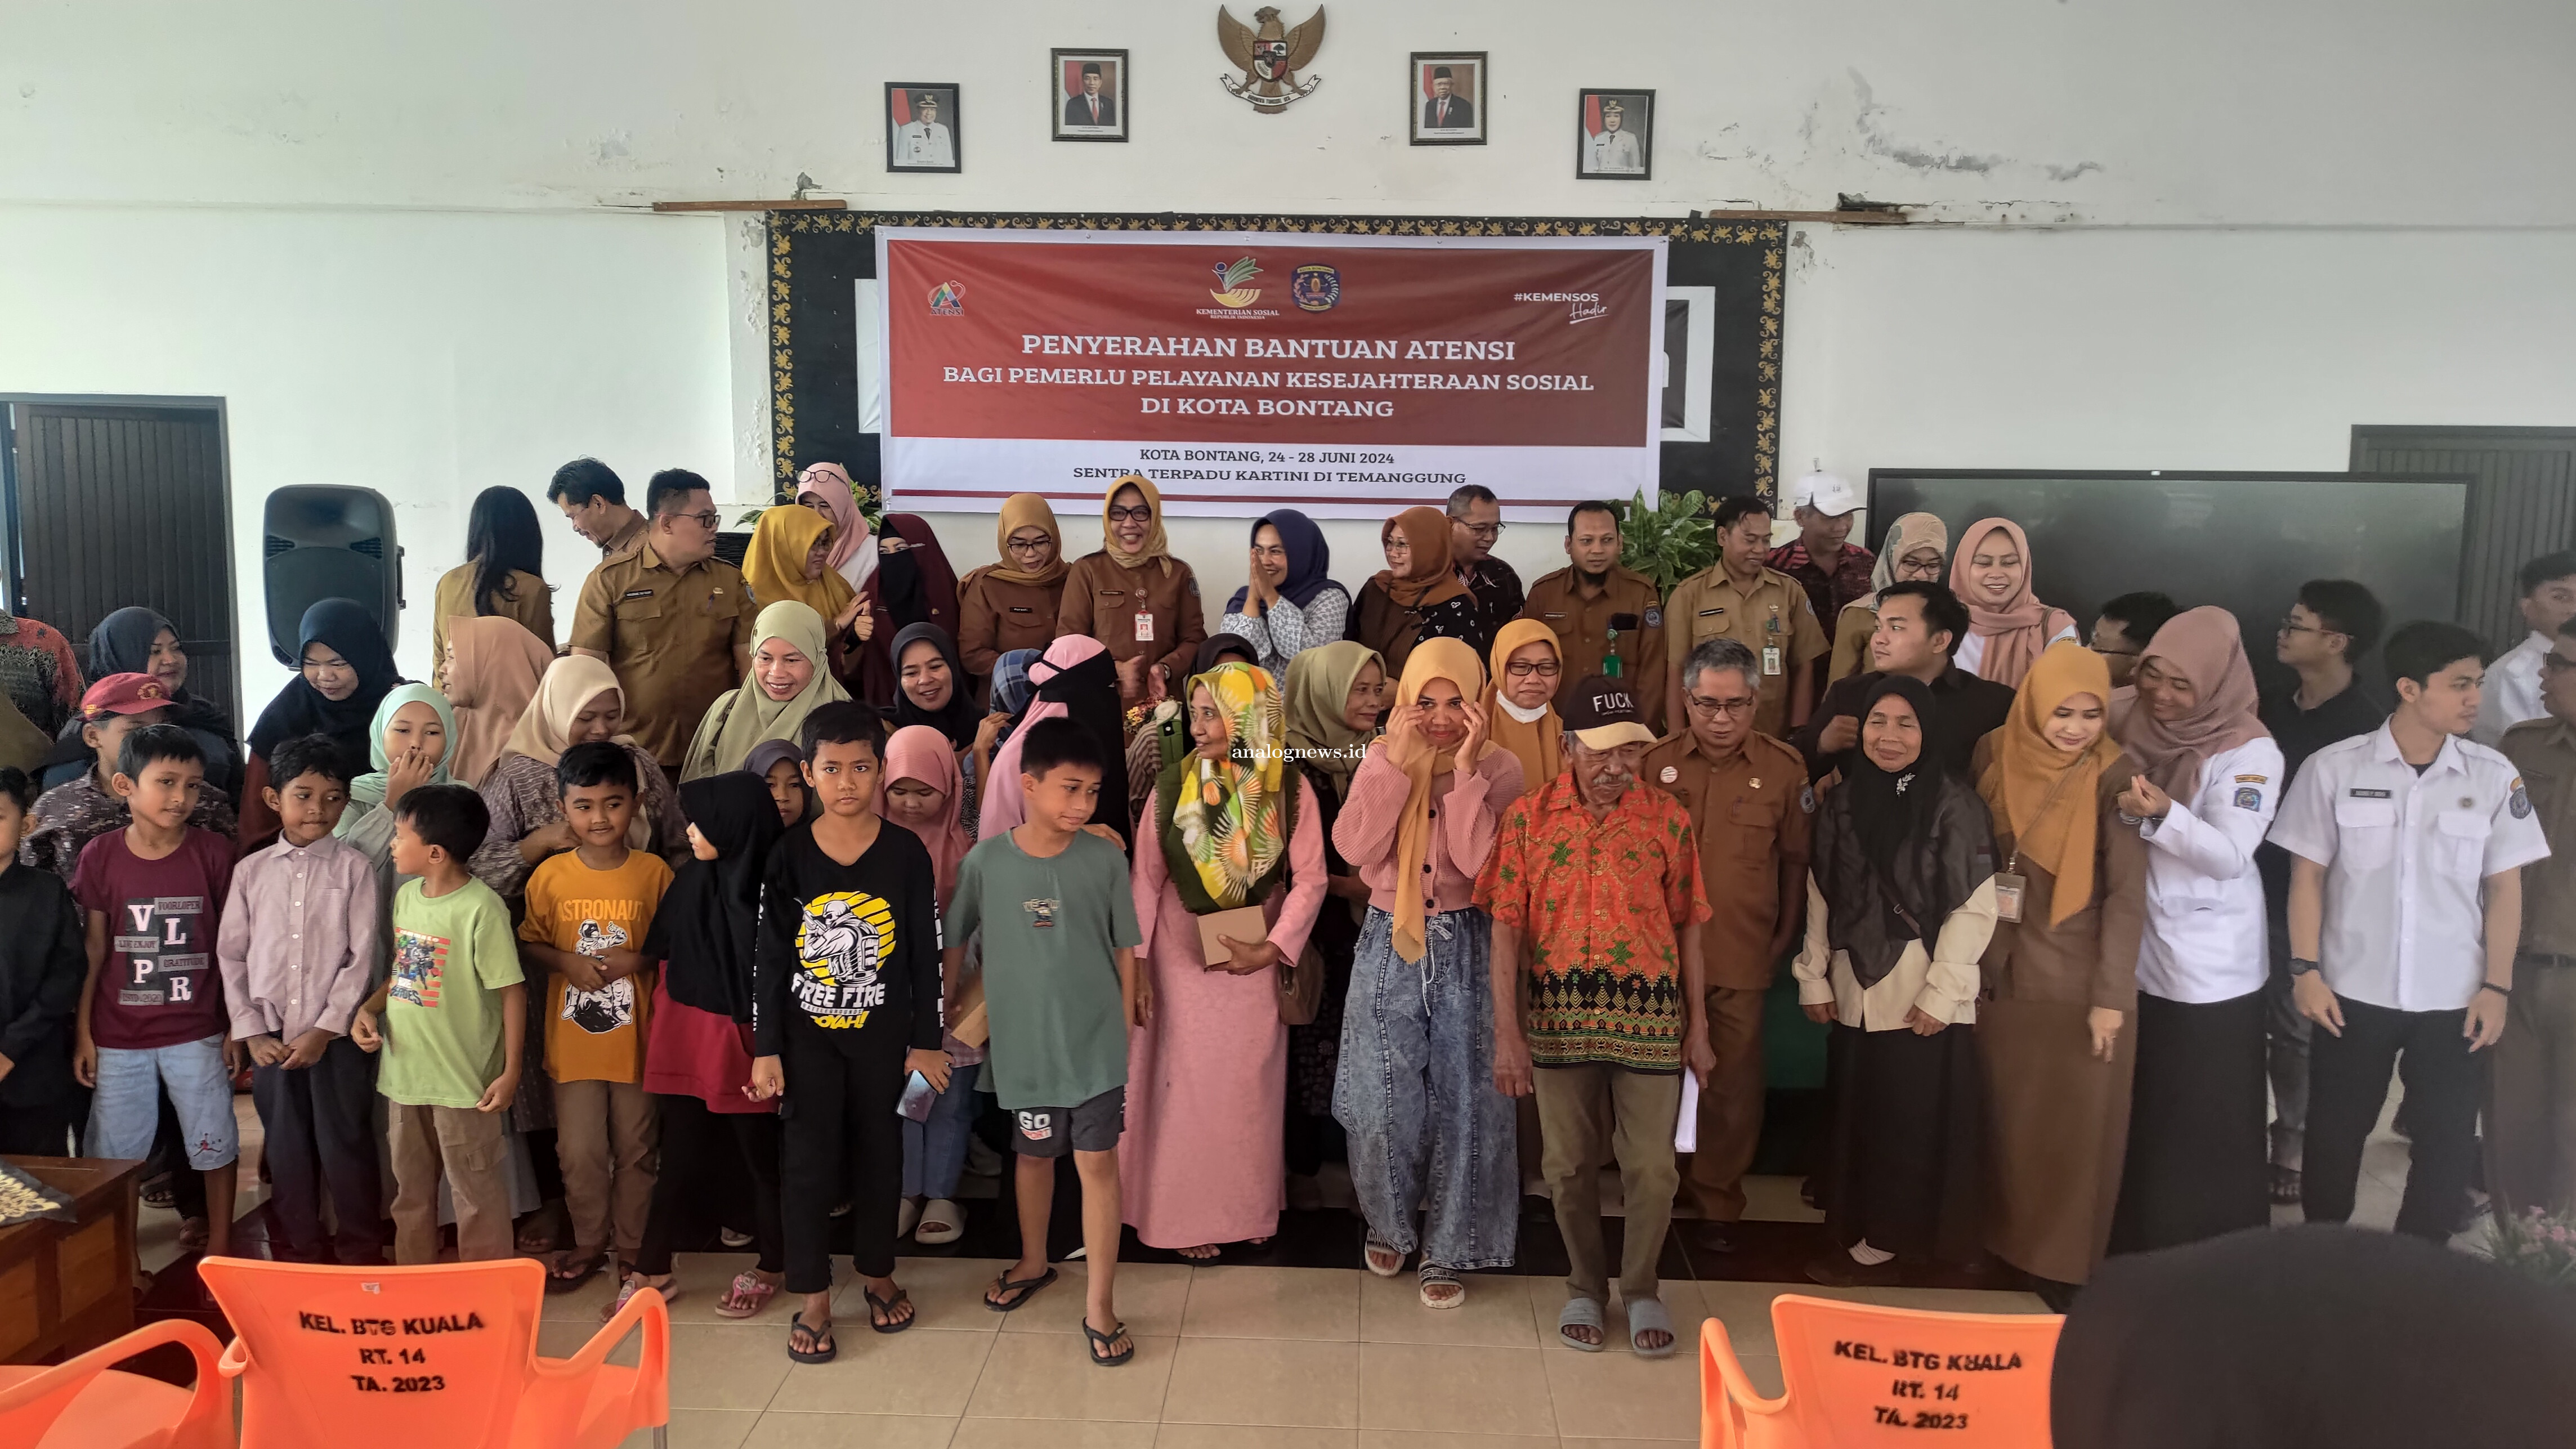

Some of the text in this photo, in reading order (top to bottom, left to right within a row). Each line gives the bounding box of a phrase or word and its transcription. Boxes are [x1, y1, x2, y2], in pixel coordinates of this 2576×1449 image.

[1513, 292, 1599, 302] #KEMENSOS
[1569, 302, 1607, 320] Hadir
[1022, 334, 1516, 361] PENYERAHAN BANTUAN ATENSI
[942, 366, 1595, 391] BAGI PEMERLU PELAYANAN KESEJAHTERAAN SOSIAL
[1141, 397, 1394, 418] DI KOTA BONTANG
[1140, 448, 1181, 461] KOTA
[1184, 449, 1264, 464] BONTANG,
[1268, 451, 1286, 463] 24
[1298, 451, 1316, 463] 28
[1318, 451, 1356, 464] JUNI
[1359, 452, 1395, 464] 2024
[1147, 468, 1232, 481] TERPADU
[1235, 470, 1309, 482] KARTINI
[1312, 471, 1333, 482] DI
[1335, 472, 1466, 484] TEMANGGUNG
[1592, 692, 1634, 712] FUCK
[127, 904, 155, 932] V
[164, 918, 187, 945] L
[133, 959, 154, 983] P
[169, 976, 192, 1001] R
[791, 972, 886, 1008] FREE FIRE
[801, 1001, 862, 1016] BATTLEGROUNDS
[1018, 1111, 1051, 1130] GO
[298, 1310, 347, 1334] KEL.
[401, 1312, 485, 1336] KUALA
[359, 1347, 427, 1365] RT. 14
[1833, 1340, 2022, 1372] KEL. BTG KUALA
[350, 1374, 446, 1393] TA. 2023
[1891, 1379, 1960, 1402] RT. 14
[1874, 1406, 1969, 1430] TA. 2023
